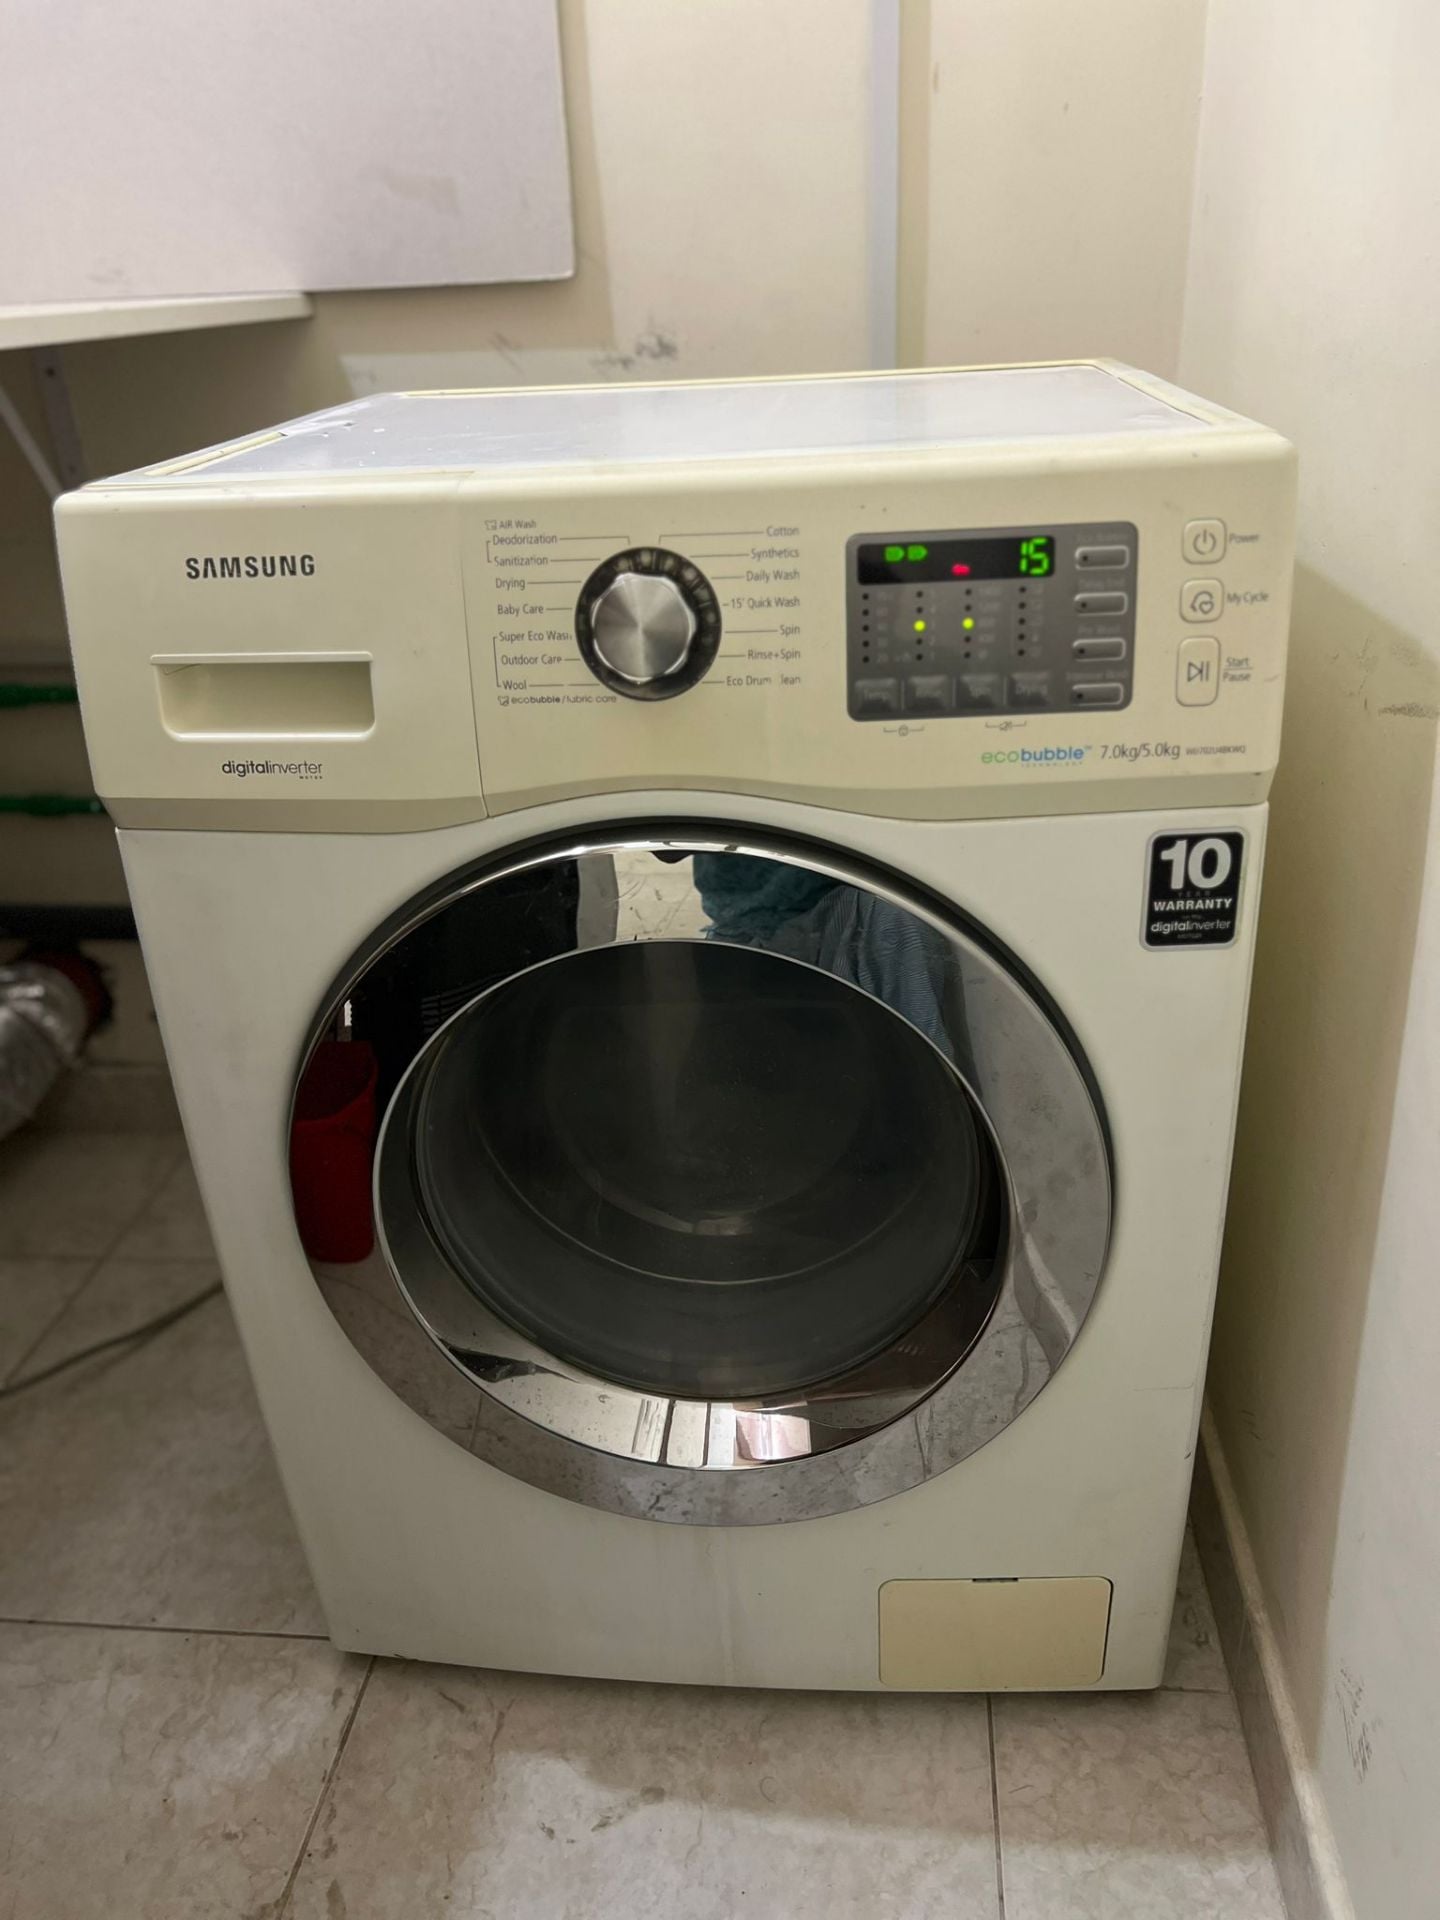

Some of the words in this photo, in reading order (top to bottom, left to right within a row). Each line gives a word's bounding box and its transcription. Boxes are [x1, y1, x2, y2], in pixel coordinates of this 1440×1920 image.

[514, 519, 537, 529] Wash
[766, 525, 800, 537] Cotton
[492, 532, 558, 545] Deodorization
[1229, 532, 1260, 544] Power
[750, 547, 800, 560] Synthetics
[1019, 536, 1050, 576] 15
[185, 554, 316, 580] SAMSUNG
[494, 554, 549, 567] Sanitization
[746, 569, 772, 582] Daily
[773, 568, 800, 580] Wash
[495, 577, 526, 590] Drying
[747, 597, 772, 610] Quick
[773, 596, 801, 608] Wash
[1226, 593, 1242, 607] My
[1242, 591, 1269, 606] Cycle
[497, 604, 520, 616] Baby
[522, 603, 544, 615] Care
[499, 631, 525, 643] Super
[527, 630, 544, 642] Eco
[779, 624, 801, 637] Spin
[501, 654, 540, 666] Outdoor
[541, 654, 562, 666] Care
[747, 648, 801, 662] Rinse+Spin
[1225, 657, 1251, 668] Start
[726, 675, 744, 687] Eco
[745, 675, 772, 687] Drum
[1222, 671, 1252, 683] Pause
[502, 679, 527, 691] Wool
[1100, 743, 1182, 763] 7.0kg/5.0kg
[221, 759, 323, 777] digitalinverter
[1160, 837, 1232, 890] 10
[1153, 897, 1233, 912] WARRANTY
[1150, 919, 1231, 935] digitalinverter
